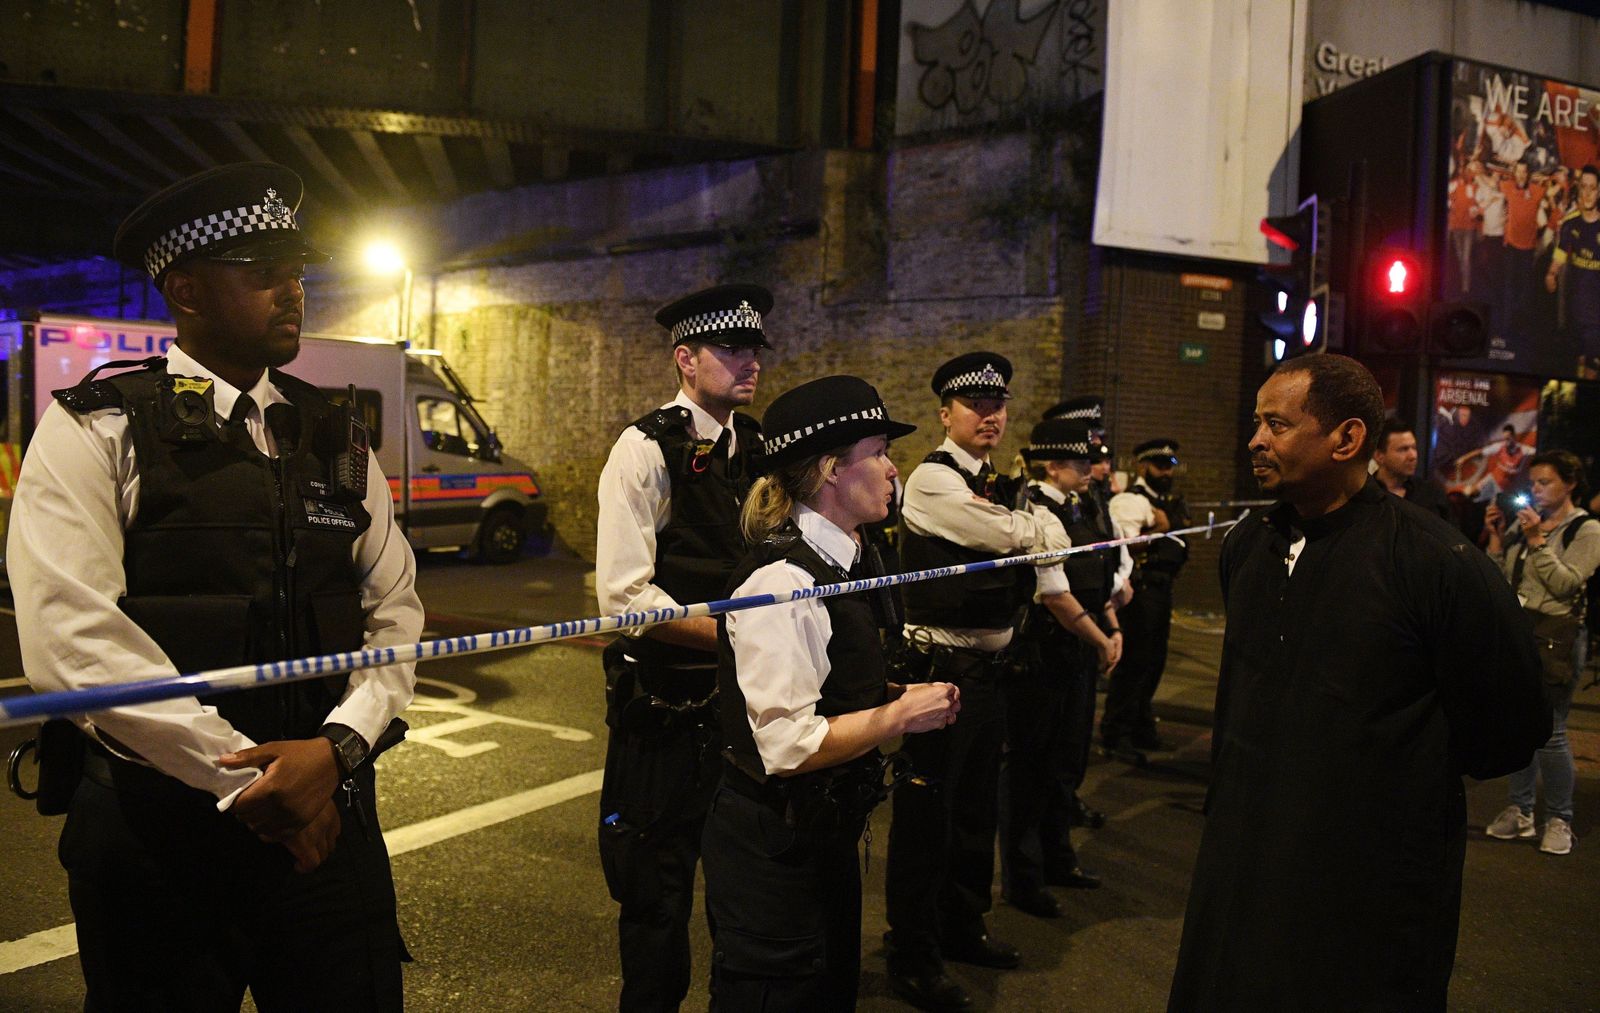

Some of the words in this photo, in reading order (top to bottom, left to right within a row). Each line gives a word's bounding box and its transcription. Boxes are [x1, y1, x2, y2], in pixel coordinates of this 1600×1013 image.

[1485, 73, 1529, 119] WE
[1536, 91, 1588, 132] ARE
[40, 328, 177, 353] POLIC
[1439, 389, 1490, 407] ARSENAL
[307, 516, 331, 525] POLICE
[331, 519, 355, 528] OFFICER
